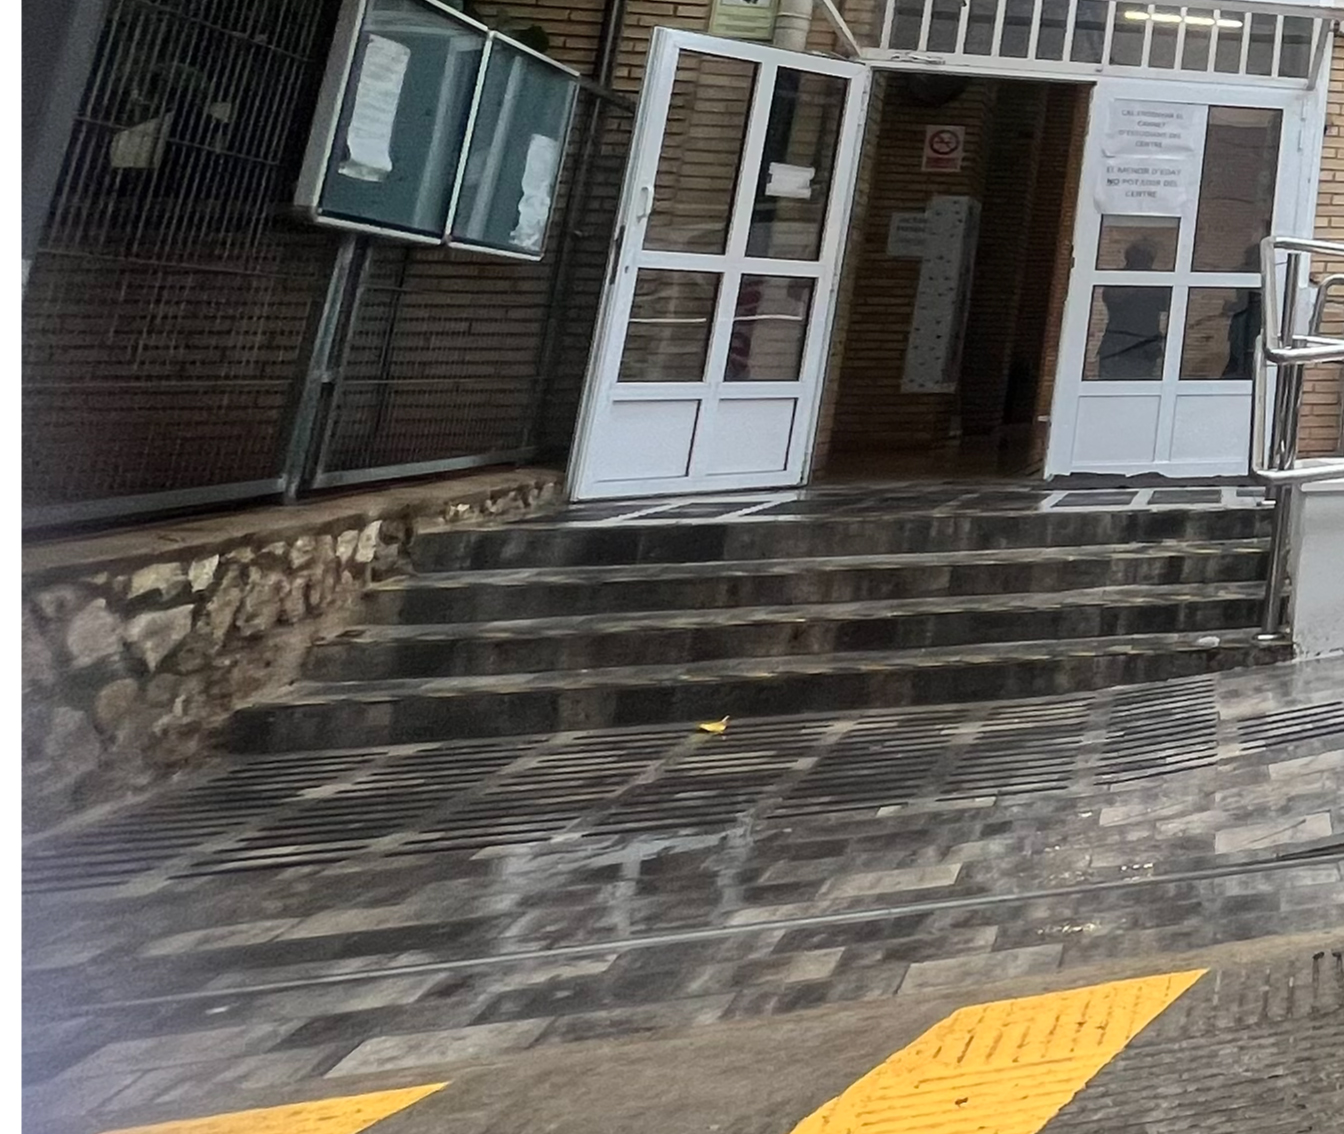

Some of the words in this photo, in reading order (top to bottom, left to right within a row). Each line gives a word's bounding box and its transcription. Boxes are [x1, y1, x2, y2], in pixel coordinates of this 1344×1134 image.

[1117, 167, 1150, 175] MENOR
[1106, 178, 1120, 186] NO
[1122, 178, 1139, 186] POT
[1125, 190, 1158, 199] CENTRE
